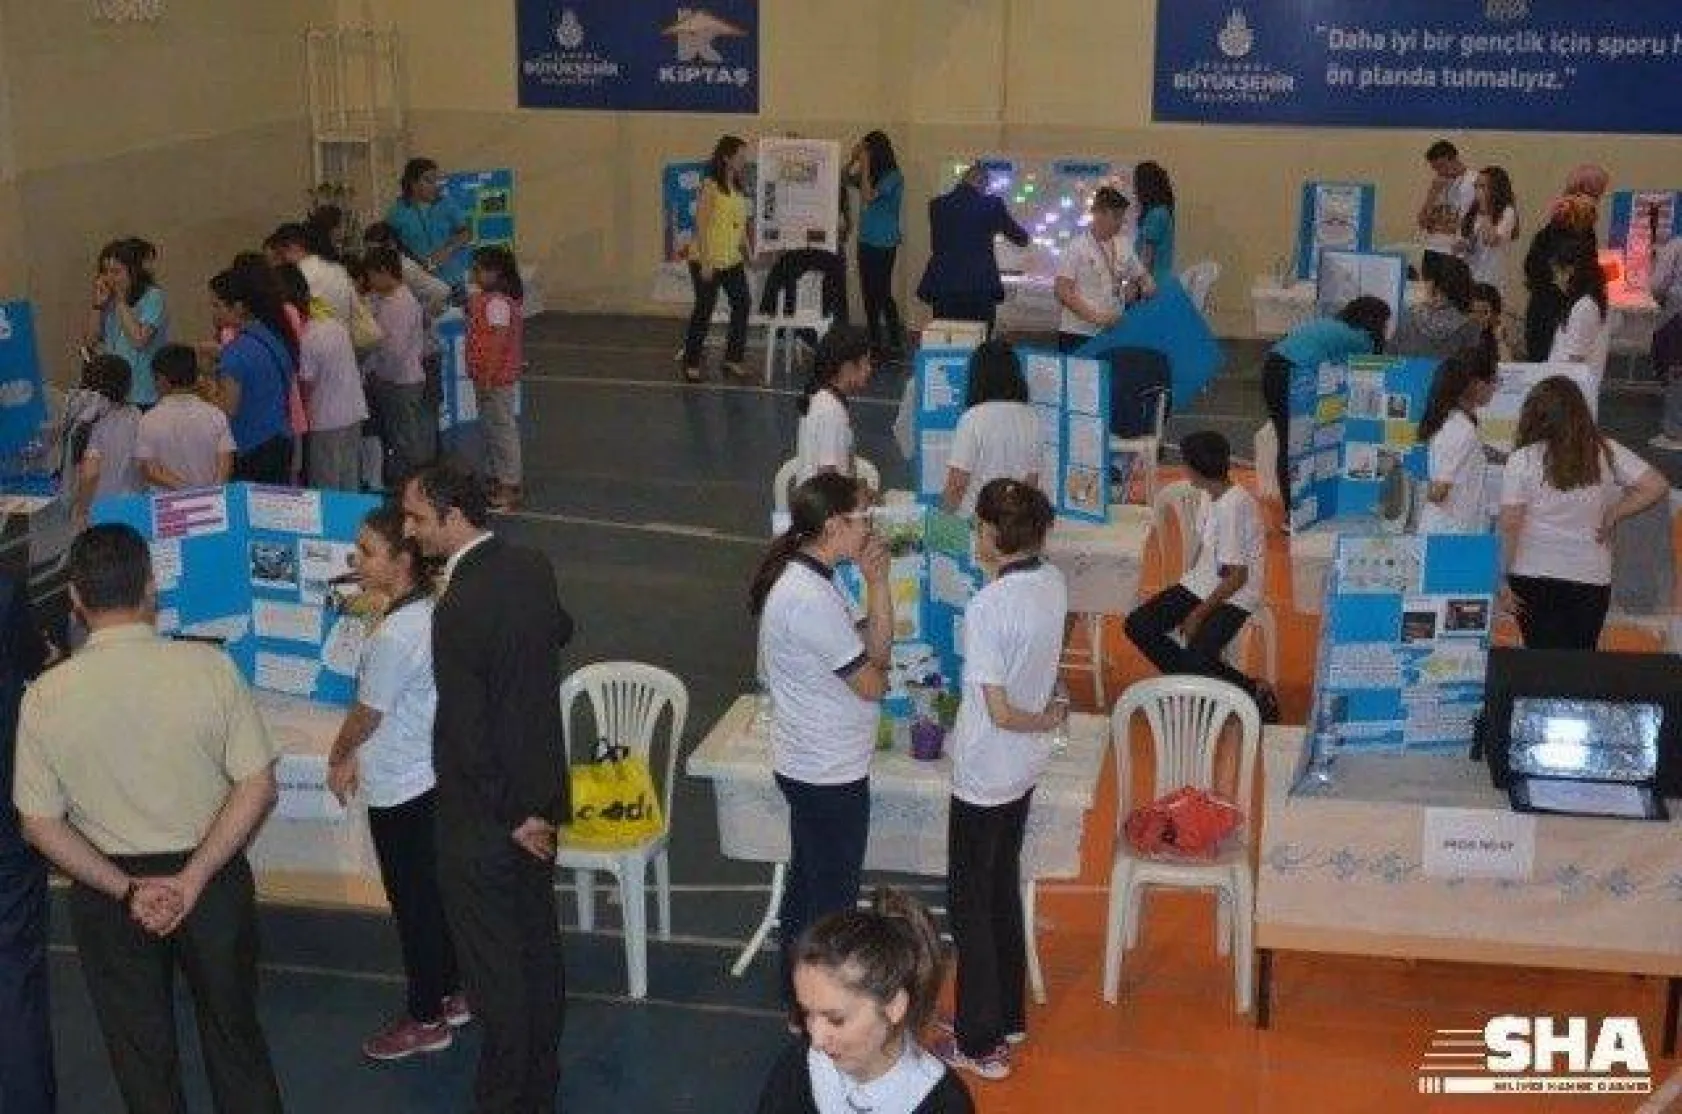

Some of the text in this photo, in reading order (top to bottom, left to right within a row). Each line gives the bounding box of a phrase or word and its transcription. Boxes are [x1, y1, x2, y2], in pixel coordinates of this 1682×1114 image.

[1392, 28, 1418, 56] iyi
[1423, 28, 1455, 51] bir
[1460, 30, 1542, 59] gençlik
[1597, 36, 1667, 60] sporu
[1326, 62, 1354, 85] ön
[1359, 65, 1436, 90] planda
